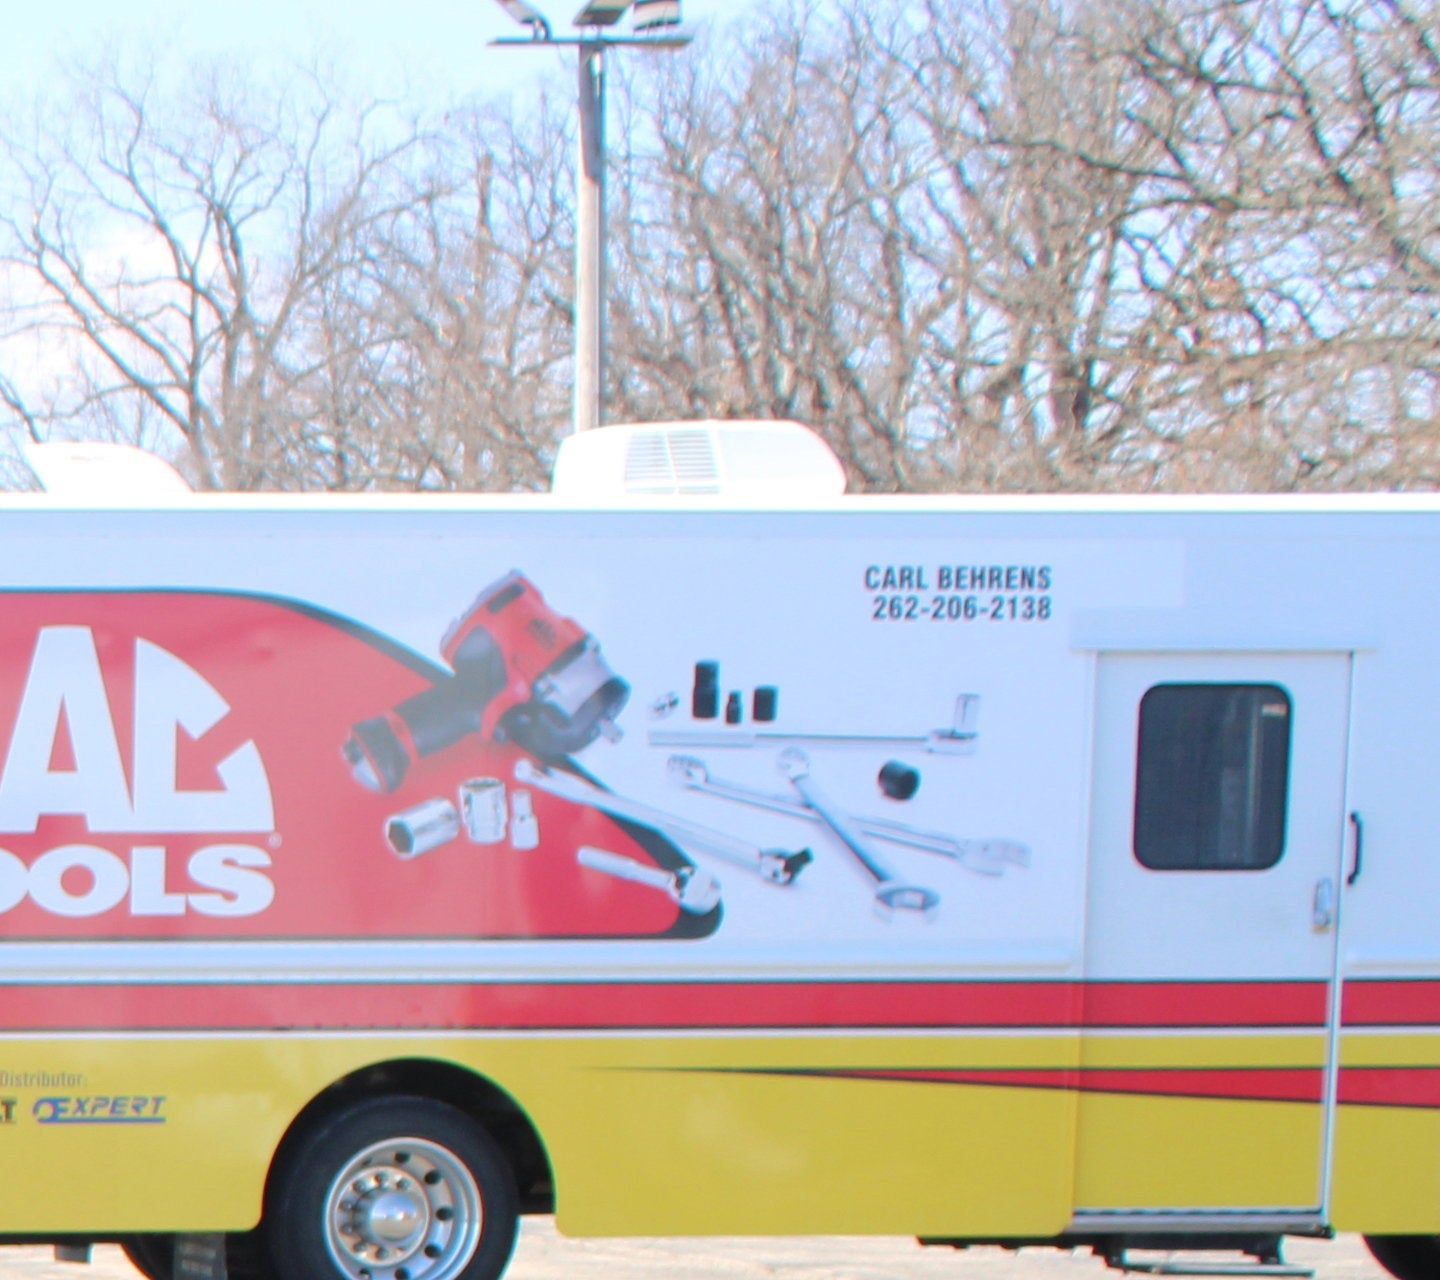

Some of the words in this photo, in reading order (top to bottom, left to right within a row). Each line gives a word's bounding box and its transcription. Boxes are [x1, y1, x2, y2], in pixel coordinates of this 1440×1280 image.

[864, 565, 928, 590] CARL
[937, 565, 1053, 590] BEHRENS
[872, 595, 1053, 621] 262-206-2138
